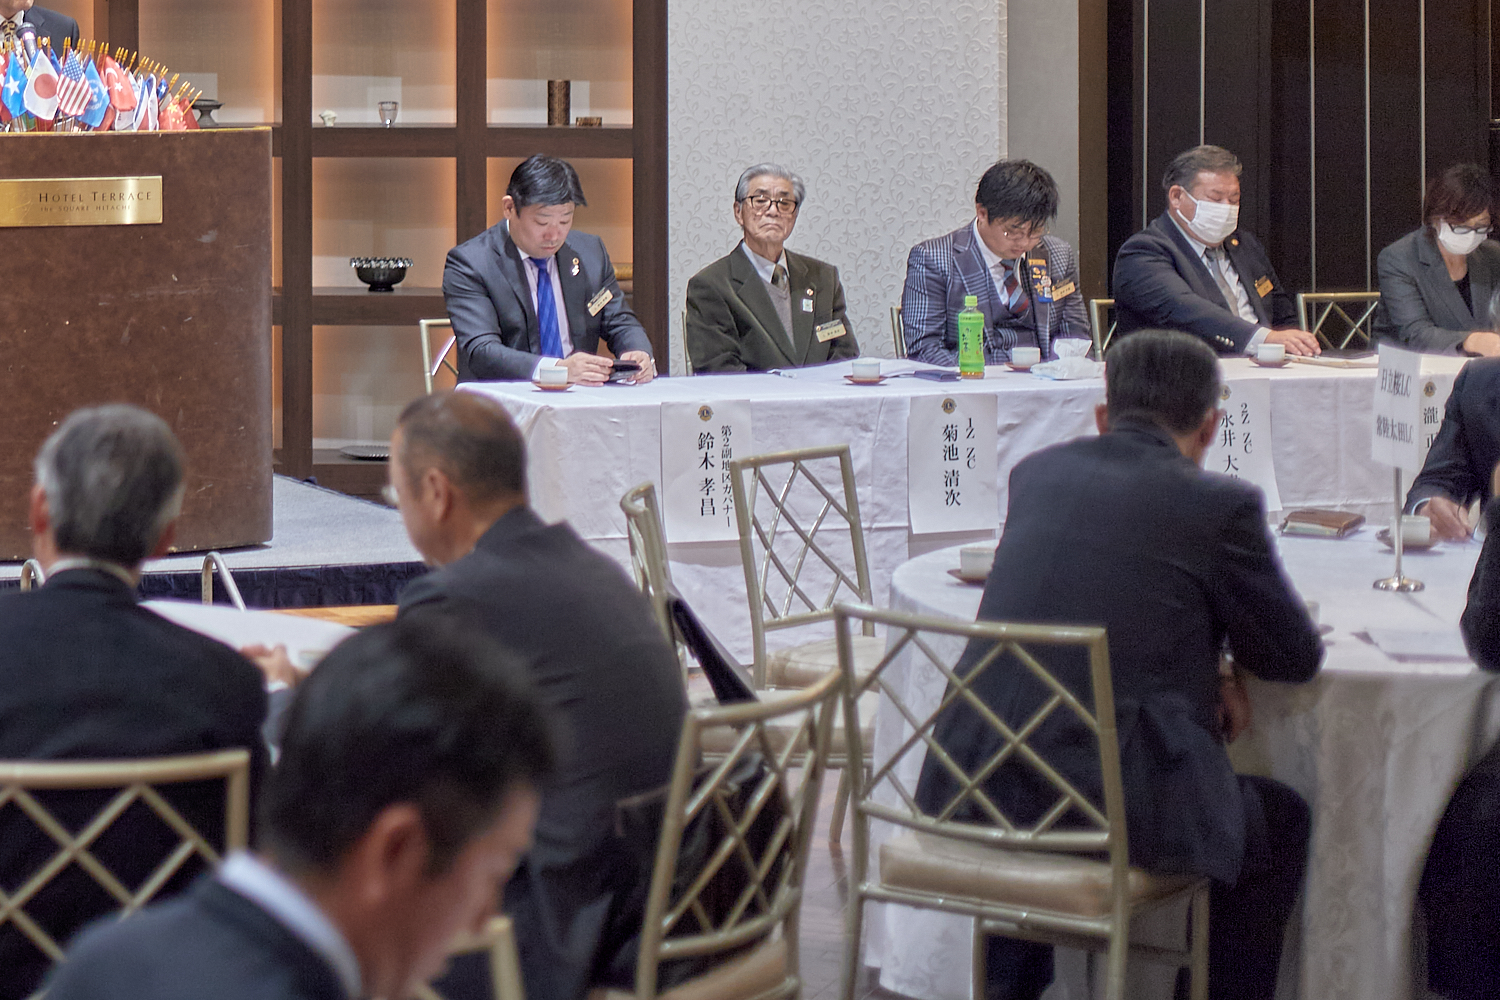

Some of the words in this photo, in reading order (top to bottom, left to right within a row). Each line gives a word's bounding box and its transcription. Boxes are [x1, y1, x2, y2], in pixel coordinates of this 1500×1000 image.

[39, 193, 83, 203] HOTEL
[92, 191, 151, 202] TERRACE
[698, 431, 715, 470] 鈴木
[699, 477, 715, 516] 孝昌
